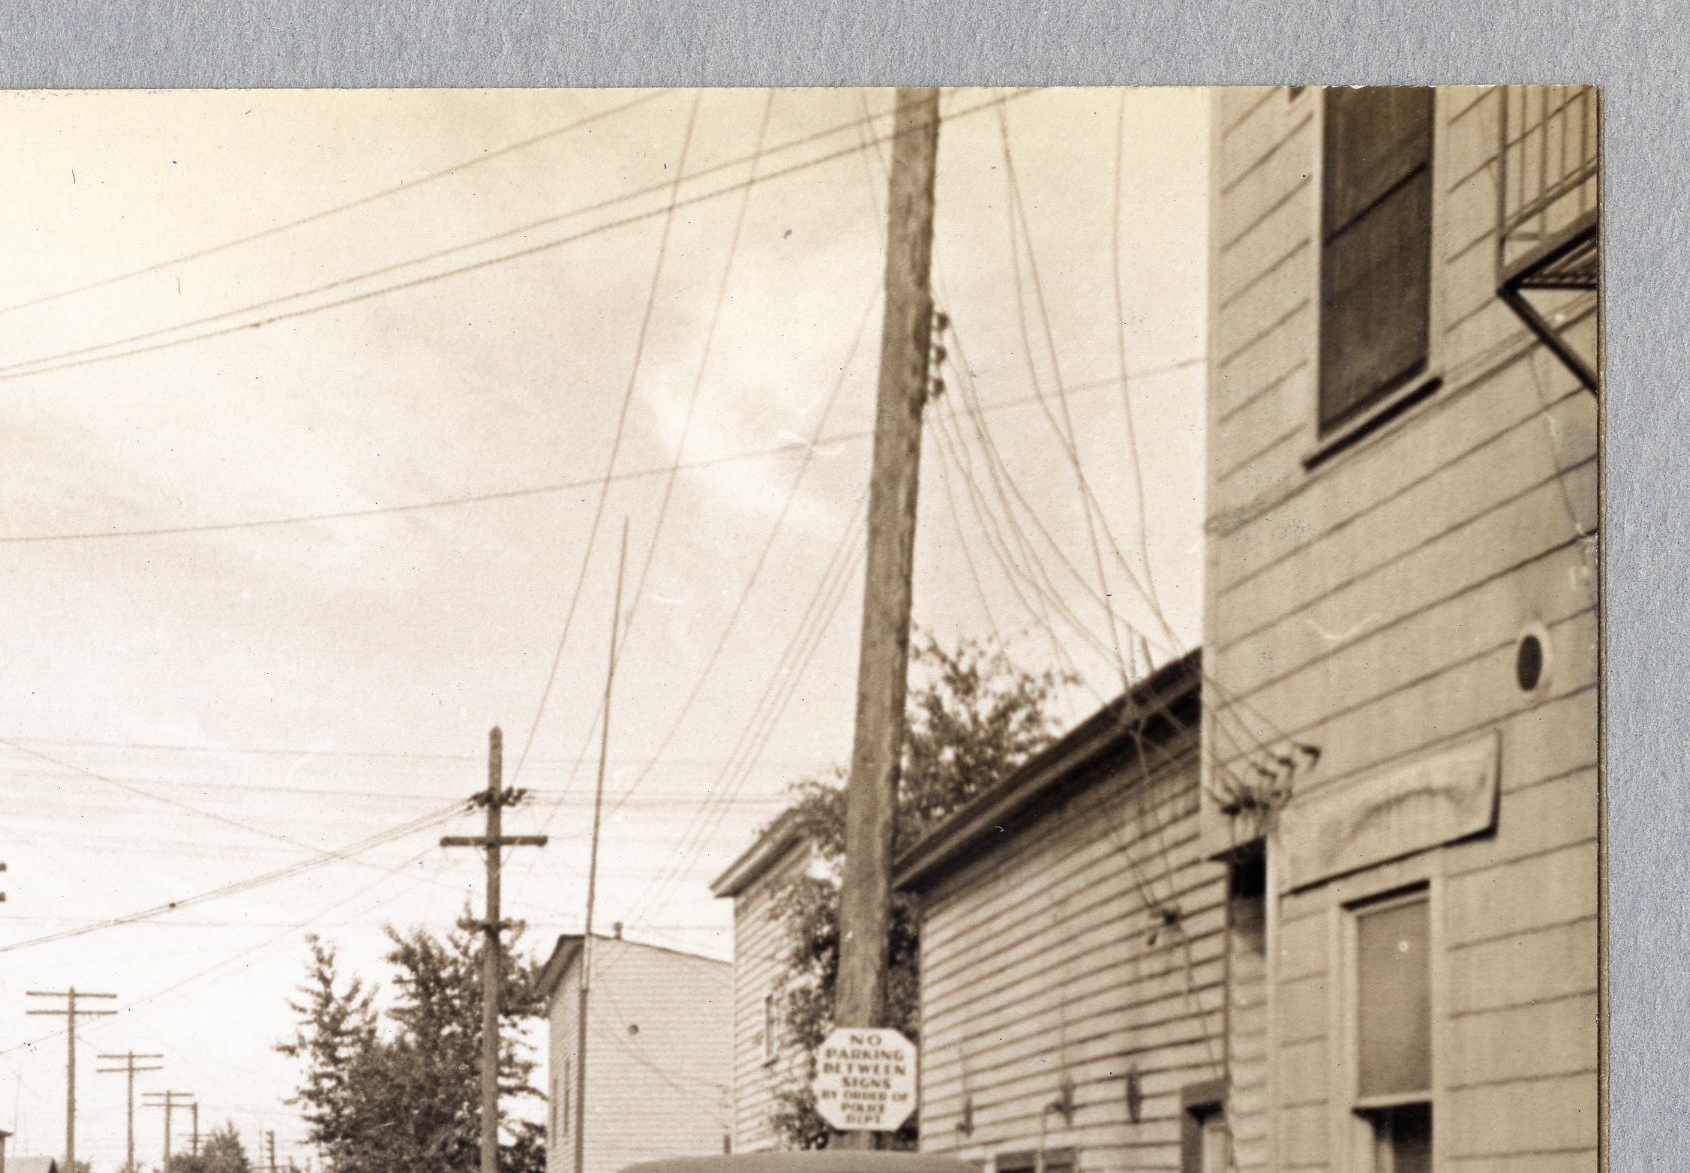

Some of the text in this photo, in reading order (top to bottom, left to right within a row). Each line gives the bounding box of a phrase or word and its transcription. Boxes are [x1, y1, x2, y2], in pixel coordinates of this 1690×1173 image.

[850, 1034, 883, 1046] NO
[825, 1048, 904, 1061] PARKING
[822, 1062, 906, 1076] BETWEEN
[842, 1077, 891, 1089] SIGNS
[821, 1090, 908, 1102] BY ORDER OF
[841, 1102, 885, 1113] POLICE
